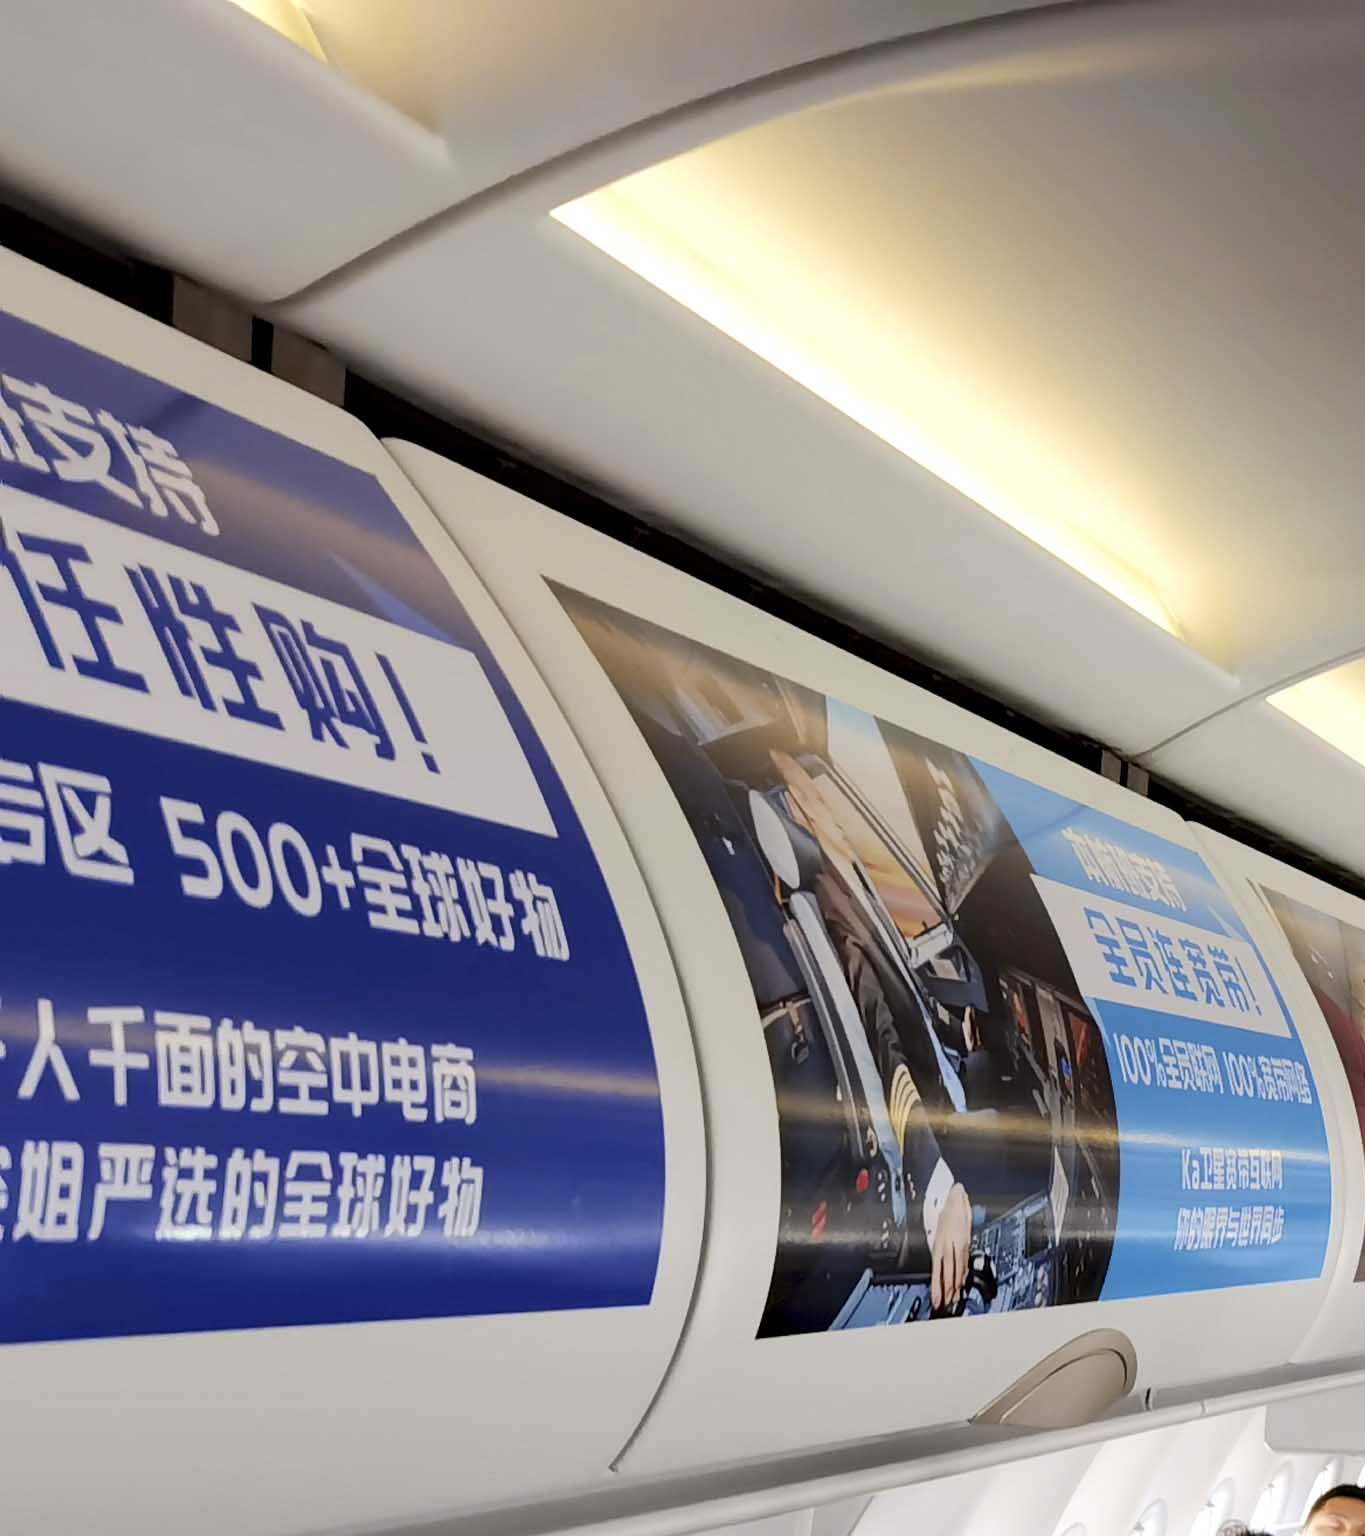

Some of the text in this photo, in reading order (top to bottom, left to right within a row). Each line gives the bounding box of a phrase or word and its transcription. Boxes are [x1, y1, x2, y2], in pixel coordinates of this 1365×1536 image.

[160, 796, 571, 962] 500+全球好物
[0, 997, 478, 1125] 人千面的空中电商
[0, 1139, 485, 1243] 姐严选的全球好物
[1181, 1147, 1284, 1190] Ka卫星宽带互联网
